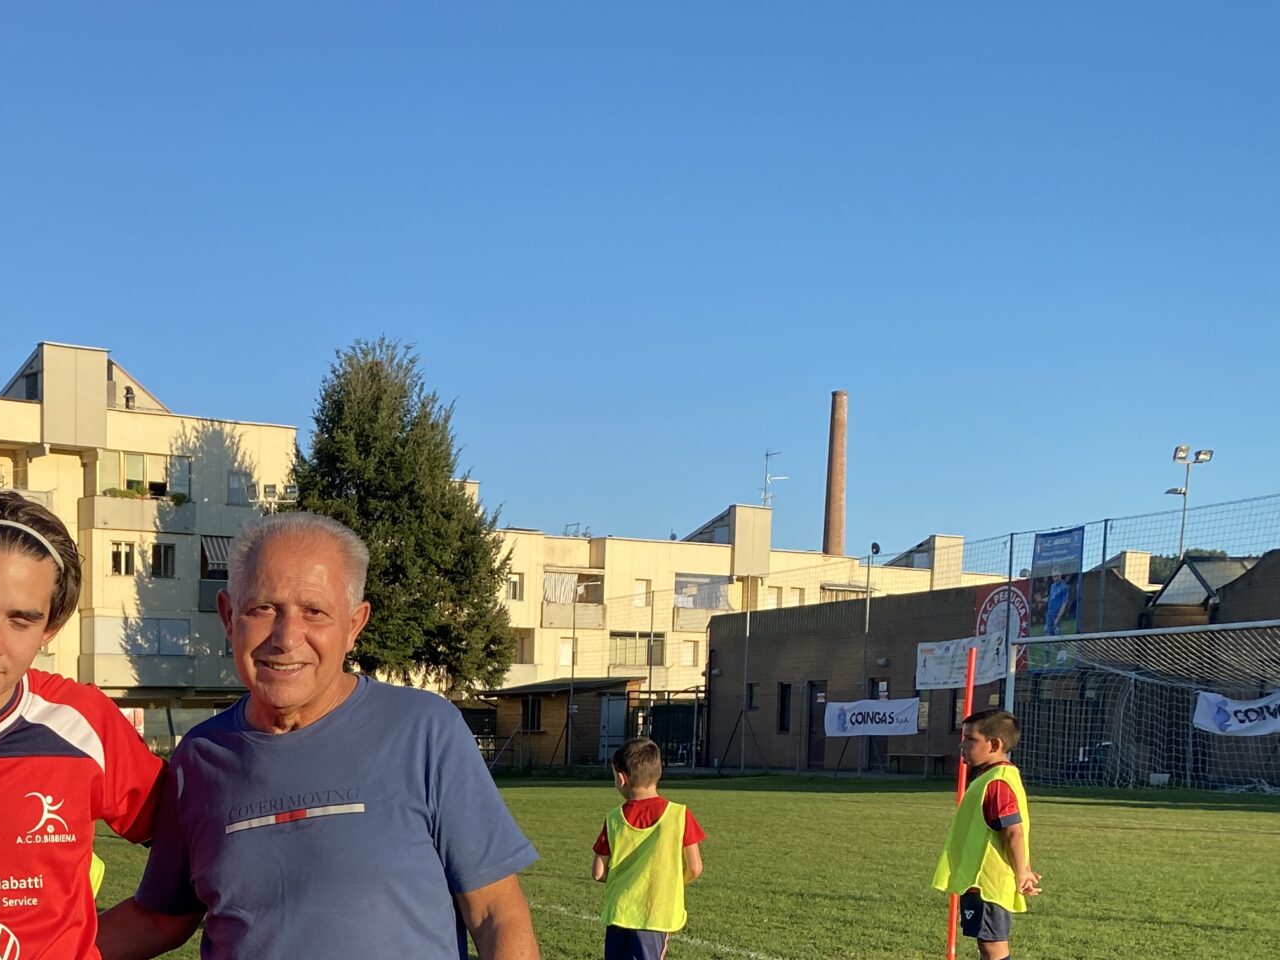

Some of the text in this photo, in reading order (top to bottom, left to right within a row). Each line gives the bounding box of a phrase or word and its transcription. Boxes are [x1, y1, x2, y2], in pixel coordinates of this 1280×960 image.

[849, 711, 895, 726] COINGAS
[228, 787, 360, 821] COVERI MOVING
[2, 895, 38, 908] Service
